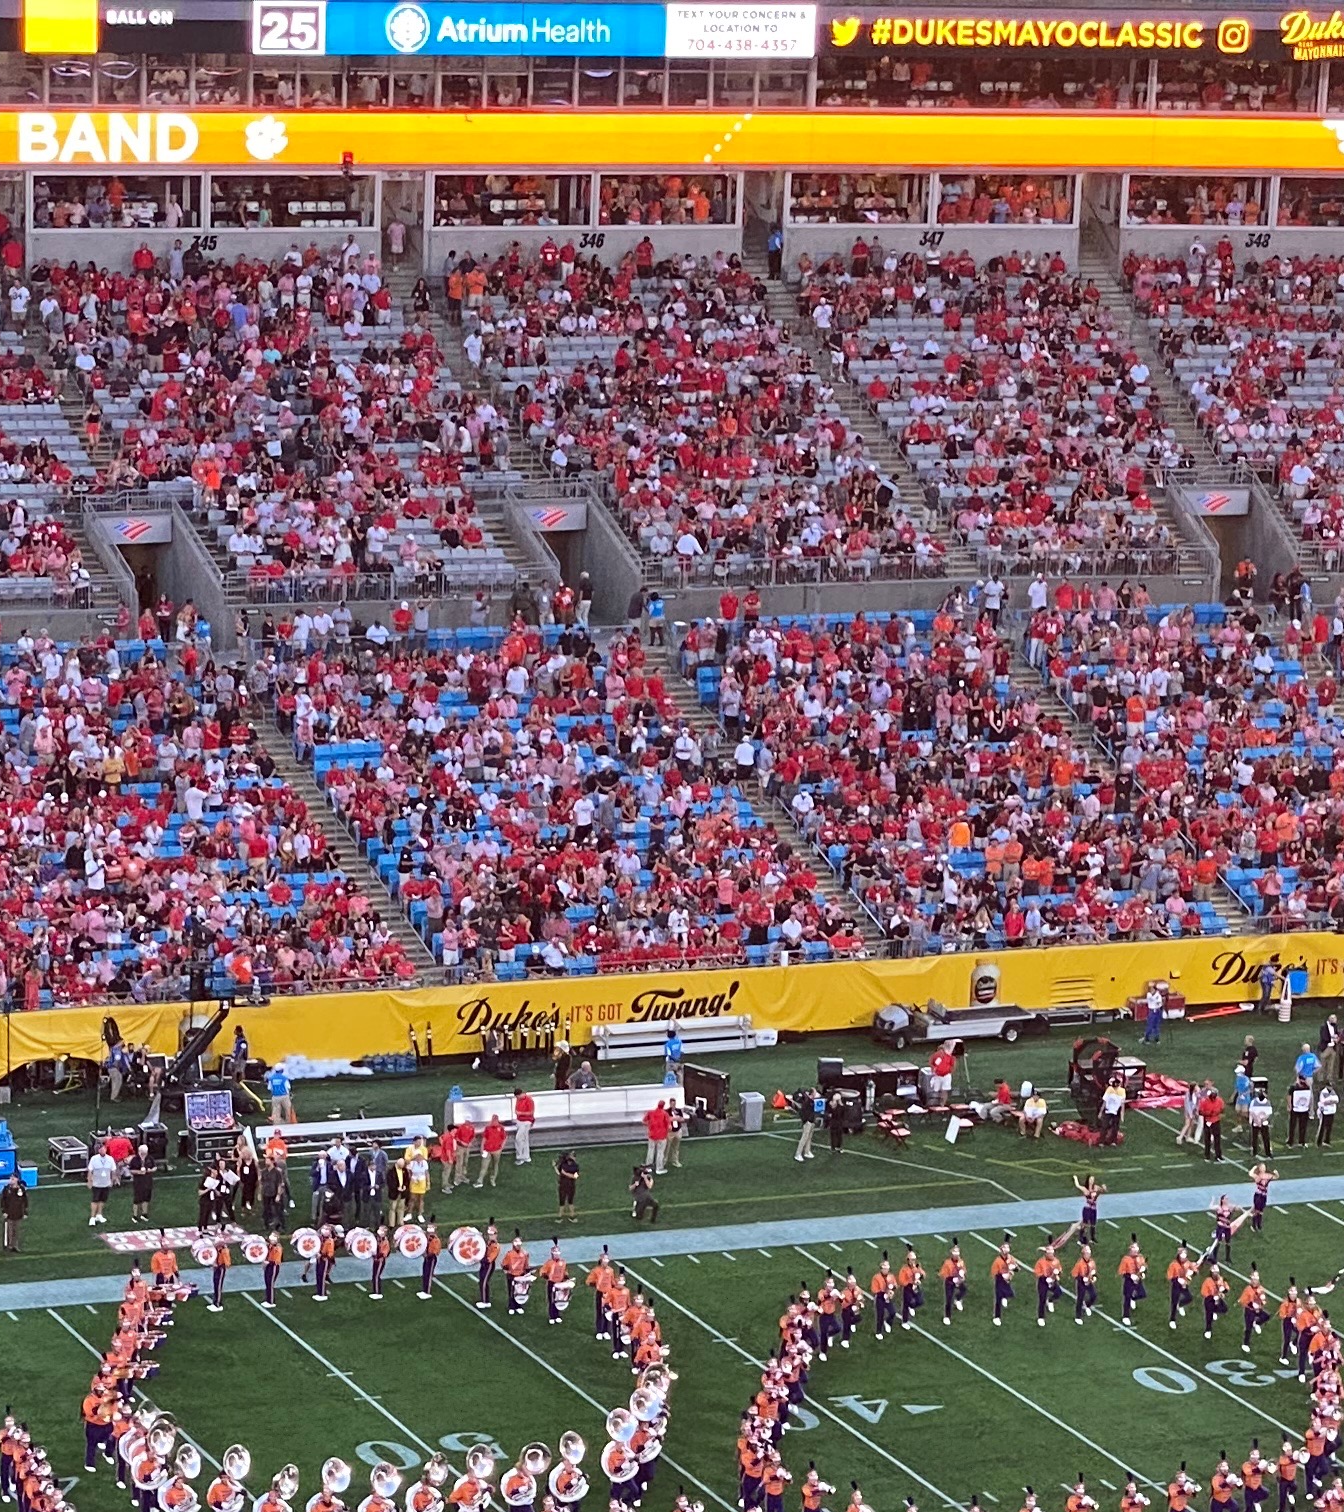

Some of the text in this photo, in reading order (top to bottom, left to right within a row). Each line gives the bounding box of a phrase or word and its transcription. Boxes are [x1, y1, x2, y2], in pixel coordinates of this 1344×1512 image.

[106, 9, 173, 25] BALL ON
[677, 11, 704, 19] TEXT
[709, 11, 739, 19] YOUR
[743, 11, 796, 19] CONCERN
[262, 12, 317, 50] 25
[437, 16, 611, 43] Atrium Health
[704, 24, 778, 33] LOCATION TO
[871, 17, 1204, 51] #DUKESMAYOCLASSIC
[688, 39, 797, 51] 704-438-4357
[18, 111, 199, 164] BAND
[580, 233, 605, 248] 346
[919, 230, 944, 246] 347
[1245, 233, 1271, 248] 348
[1316, 958, 1338, 976] IT'S
[456, 981, 740, 1036] Duke's IT'S GOT Twang!
[1132, 1358, 1277, 1396] 30
[356, 1432, 506, 1470] 50
